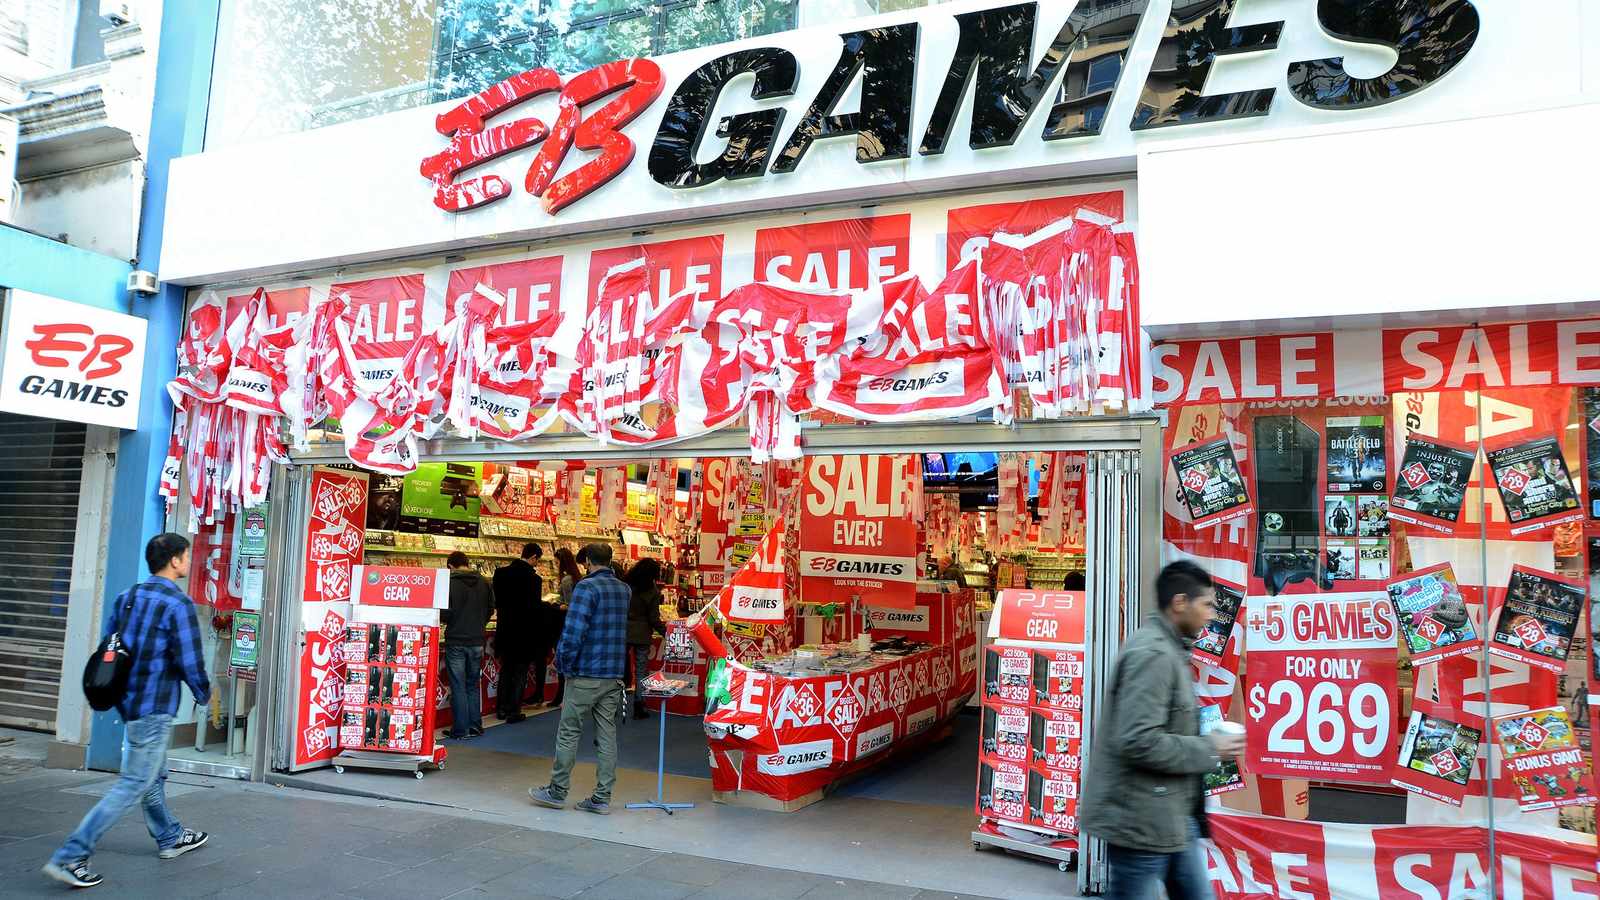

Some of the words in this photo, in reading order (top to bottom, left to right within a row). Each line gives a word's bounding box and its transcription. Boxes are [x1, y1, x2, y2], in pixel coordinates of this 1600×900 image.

[420, 57, 666, 216] EB
[647, 0, 1480, 190] GAMES
[765, 245, 896, 290] SALE
[351, 299, 416, 344] ALE
[25, 323, 134, 380] EB
[1401, 319, 1600, 390] SALE
[1151, 335, 1320, 404] SALE
[19, 375, 129, 408] GAMES
[1415, 449, 1463, 467] INJUSTICE
[806, 456, 915, 517] SALE
[318, 488, 346, 519] SALE
[833, 519, 883, 547] EVER!
[809, 556, 837, 572] EB
[836, 560, 905, 576] GAMES
[383, 575, 411, 586] XBOX
[412, 575, 431, 586] 360
[383, 586, 411, 602] GEAR
[738, 596, 751, 608] EB
[1017, 592, 1074, 609] PS3
[887, 612, 924, 623] GAMES
[1249, 602, 1285, 642] +5
[1292, 600, 1394, 642] GAMES
[1026, 618, 1058, 638] GEAR
[1009, 659, 1029, 670] GAMES
[1071, 665, 1079, 676] 12
[1285, 656, 1316, 679] FOR
[1320, 658, 1362, 680] ONLY
[1008, 686, 1029, 701] $359
[1058, 693, 1081, 708] $299
[793, 696, 815, 717] $36
[834, 703, 859, 726] SALE
[1007, 717, 1026, 727] GAMES
[1249, 679, 1390, 758] $269
[1067, 724, 1076, 736] 12
[870, 733, 891, 748] GAMES
[787, 750, 827, 766] GAMES
[1004, 744, 1027, 759] $359
[1551, 748, 1583, 766] GIANT
[1056, 754, 1078, 770] $299
[1003, 774, 1023, 785] GAMES
[1065, 784, 1074, 795] 12
[1001, 801, 1024, 818] $359
[1052, 814, 1075, 830] $299
